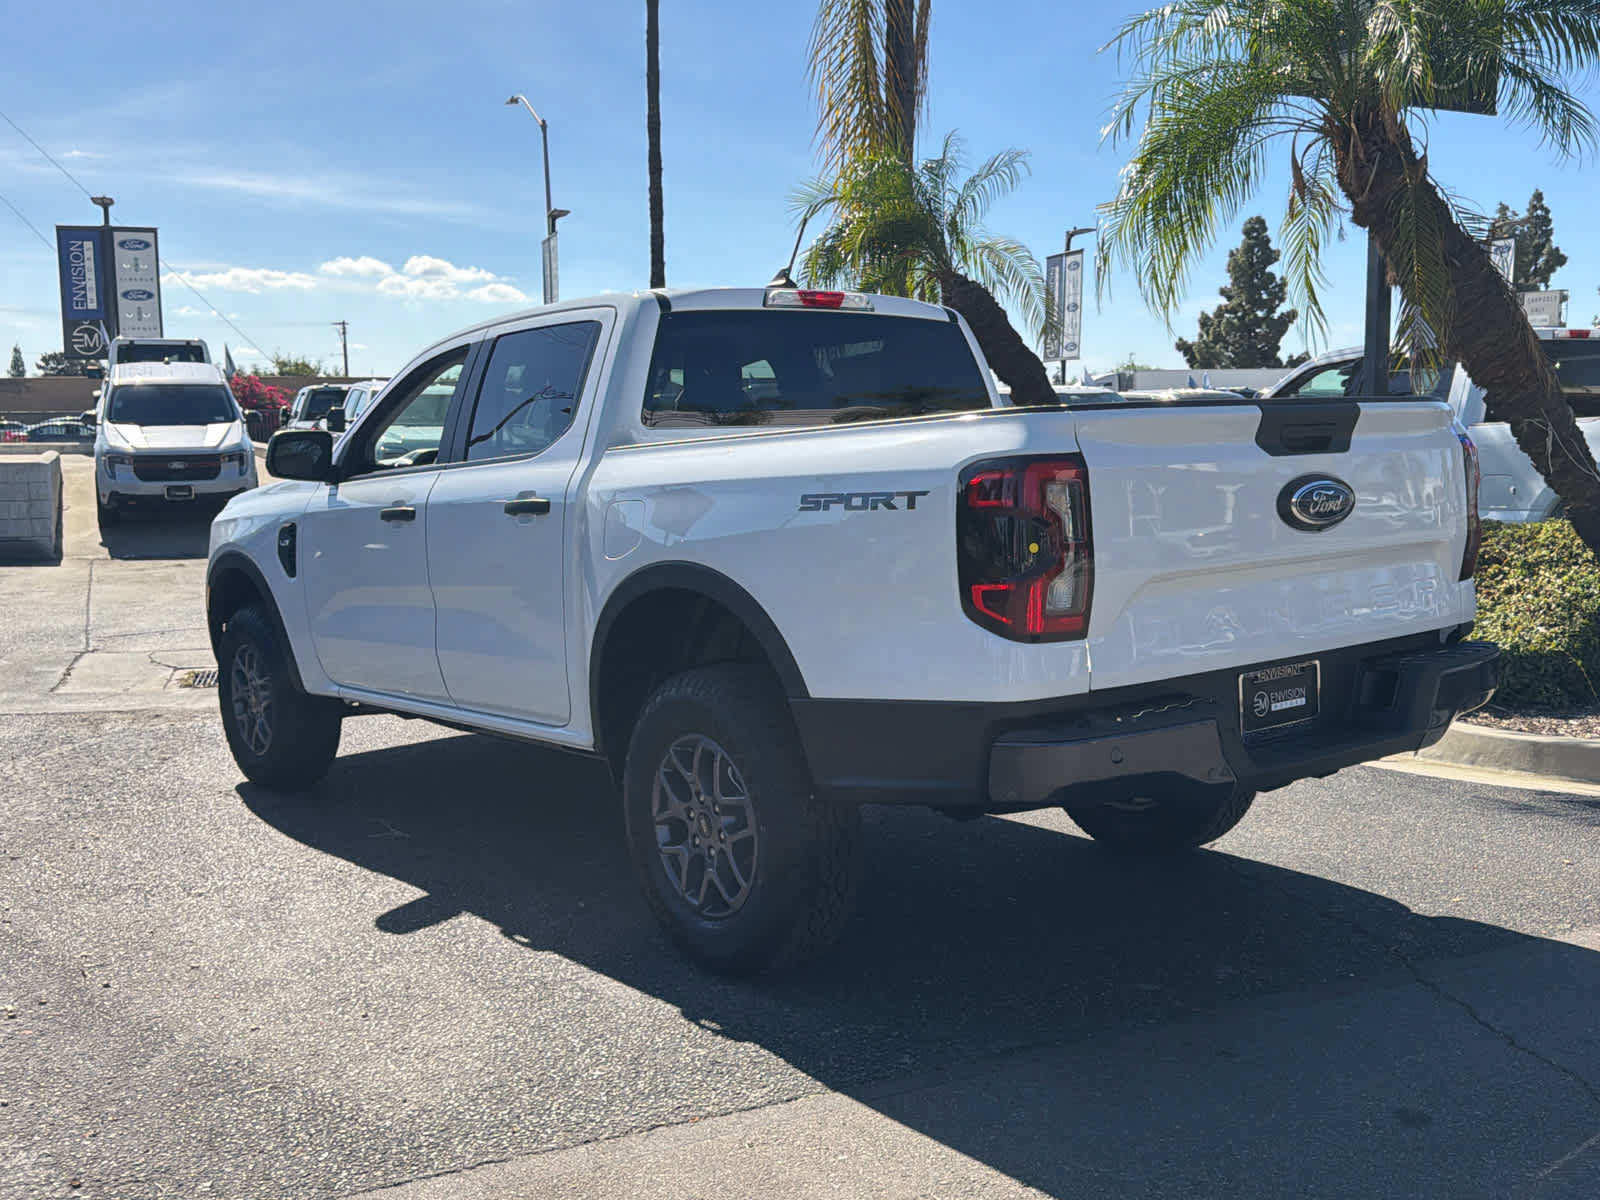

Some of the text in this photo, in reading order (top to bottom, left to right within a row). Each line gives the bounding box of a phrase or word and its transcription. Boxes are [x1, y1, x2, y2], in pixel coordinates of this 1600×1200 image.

[68, 240, 87, 310] ENVISION
[798, 490, 930, 512] SPORT
[1309, 489, 1344, 514] Ford
[1259, 664, 1301, 681] ENVISION
[1270, 687, 1306, 703] ENVISION
